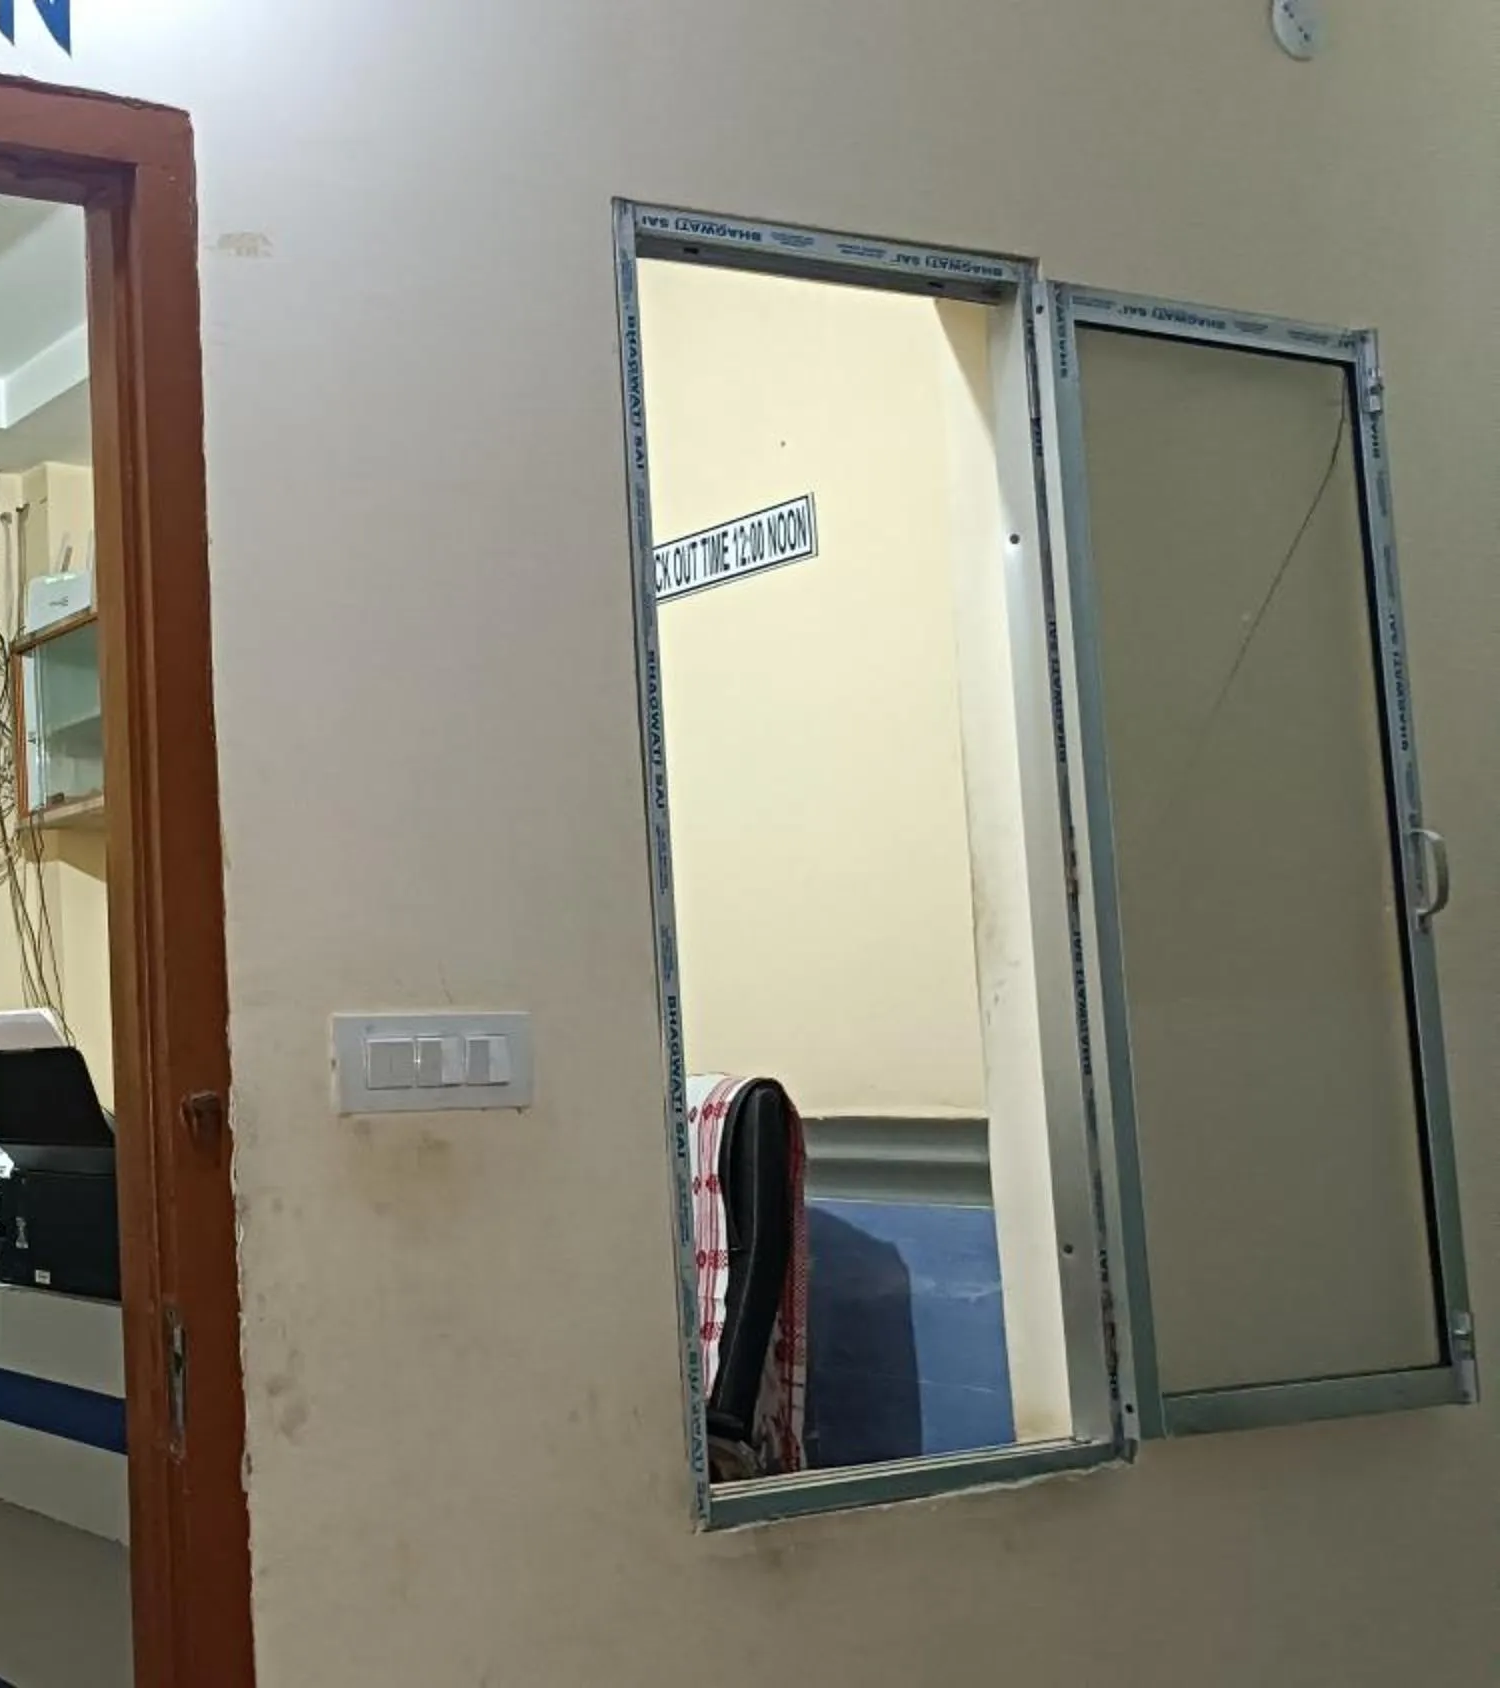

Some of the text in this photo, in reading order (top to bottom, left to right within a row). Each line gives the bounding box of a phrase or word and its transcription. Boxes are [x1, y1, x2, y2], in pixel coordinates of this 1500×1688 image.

[642, 215, 669, 228] SAI
[675, 218, 762, 242] BHAGWATI
[634, 435, 645, 469] SAI
[674, 542, 698, 586] OUT
[700, 531, 730, 577] TIME
[768, 506, 808, 558] NOON
[649, 650, 665, 809] BHAGWATI SAI
[667, 995, 683, 1114] BHAGWATI
[675, 1122, 686, 1159] SAI
